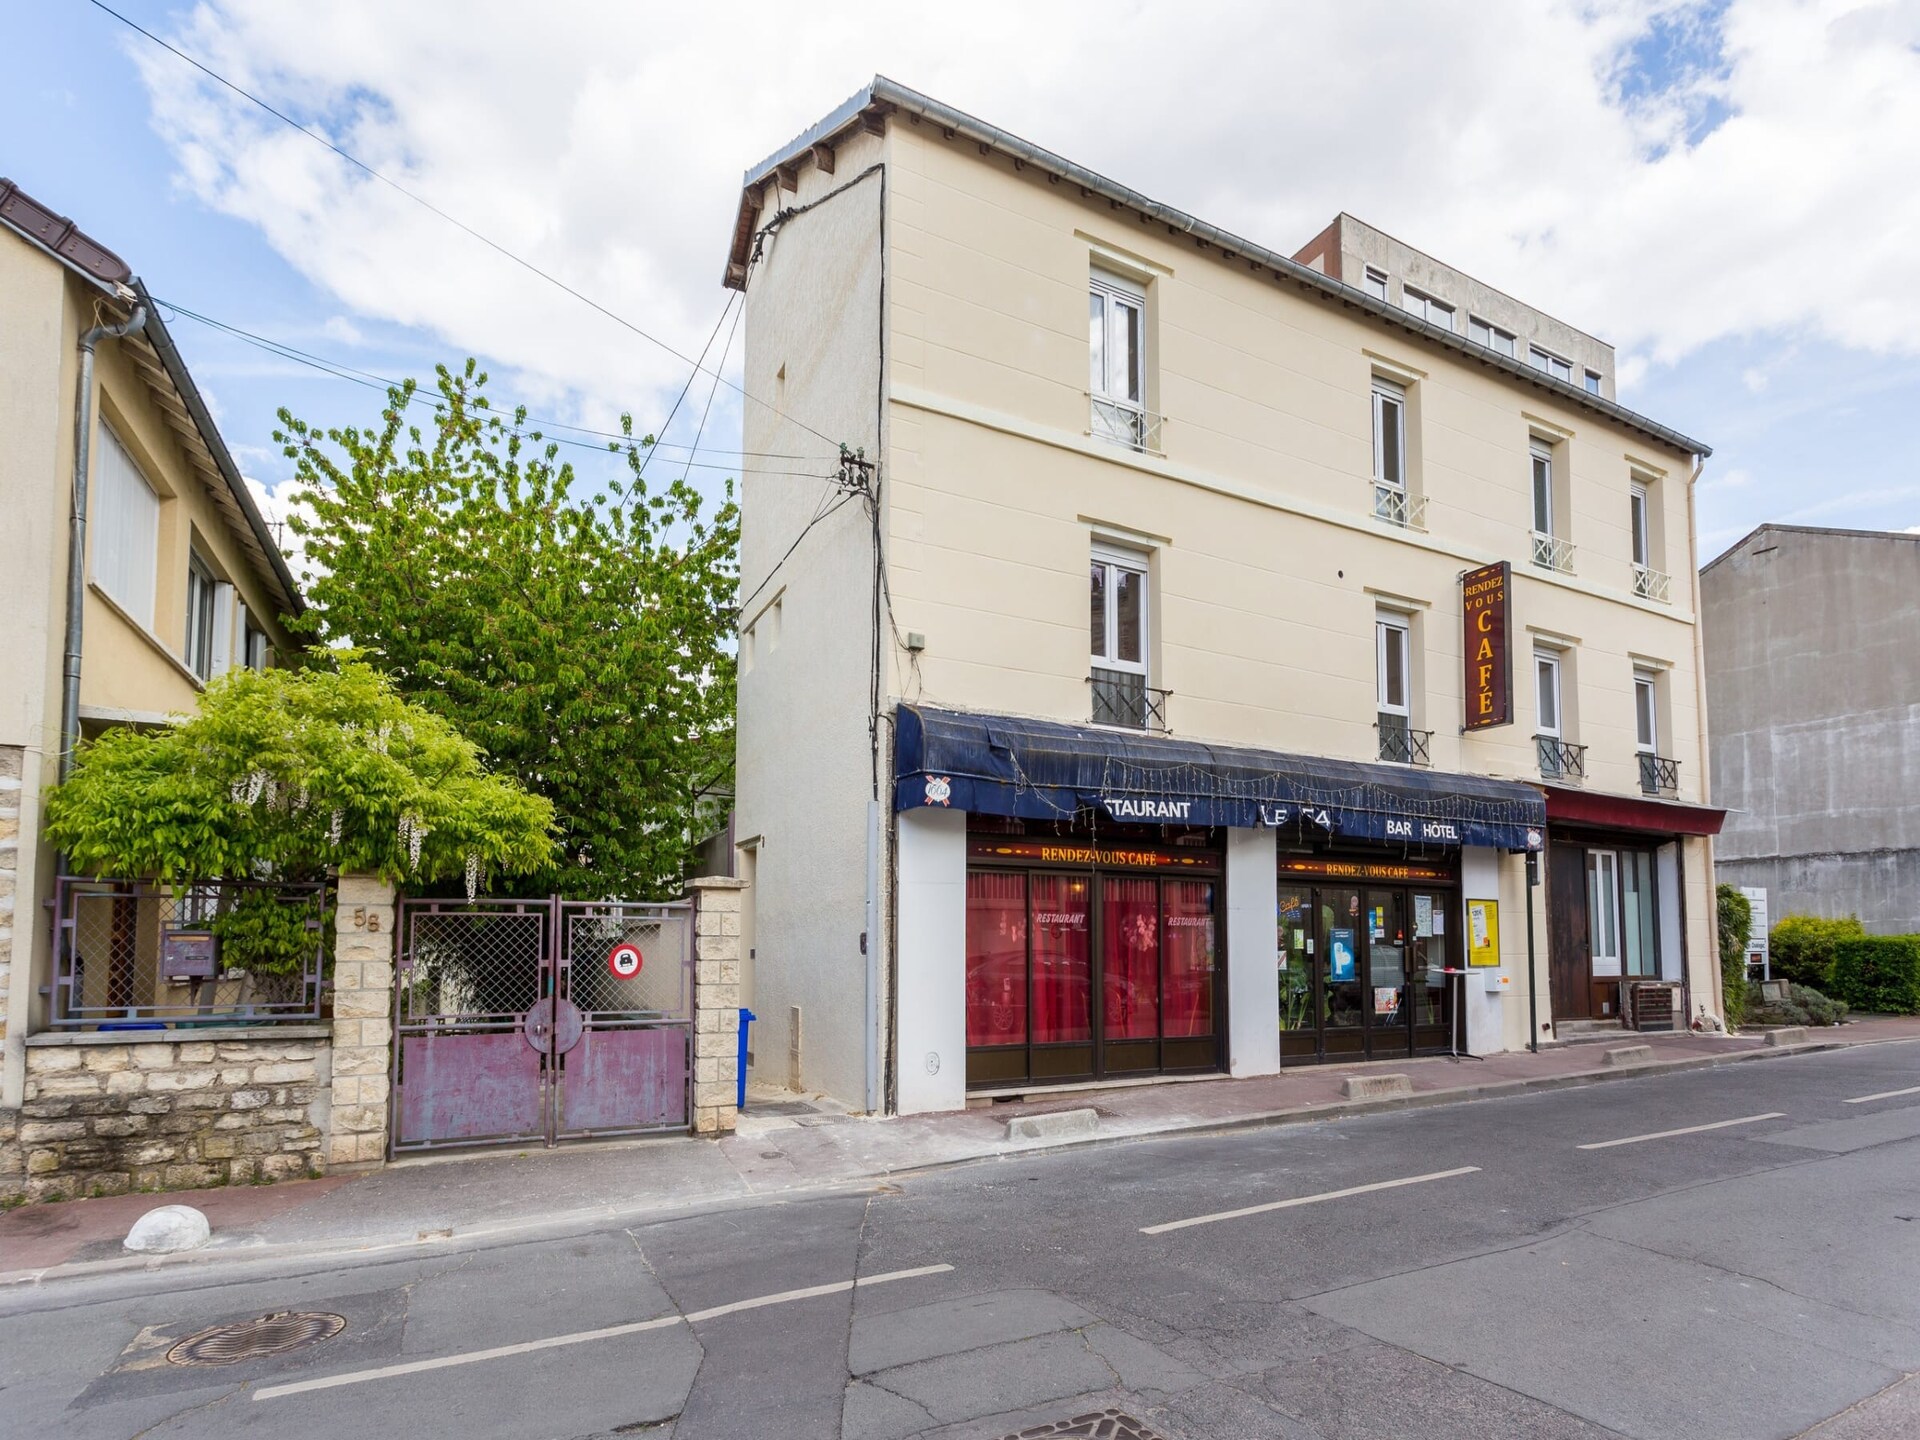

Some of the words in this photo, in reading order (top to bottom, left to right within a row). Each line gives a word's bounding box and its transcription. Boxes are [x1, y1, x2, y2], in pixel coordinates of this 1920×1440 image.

[1465, 576, 1503, 597] RENDEZ
[1465, 590, 1504, 611] VOUS
[1475, 609, 1494, 715] CAFÉ
[1260, 805, 1288, 825] LE
[1387, 820, 1412, 836] BAR
[1423, 821, 1458, 839] HÔTEL
[1041, 847, 1127, 865] RENDEZ-VOUS
[1128, 850, 1157, 866] CAFÉ
[1326, 863, 1387, 877] RENDEZ-VOUS
[1036, 913, 1086, 924] RESTAURANT
[1167, 916, 1210, 927] RESTAURANT
